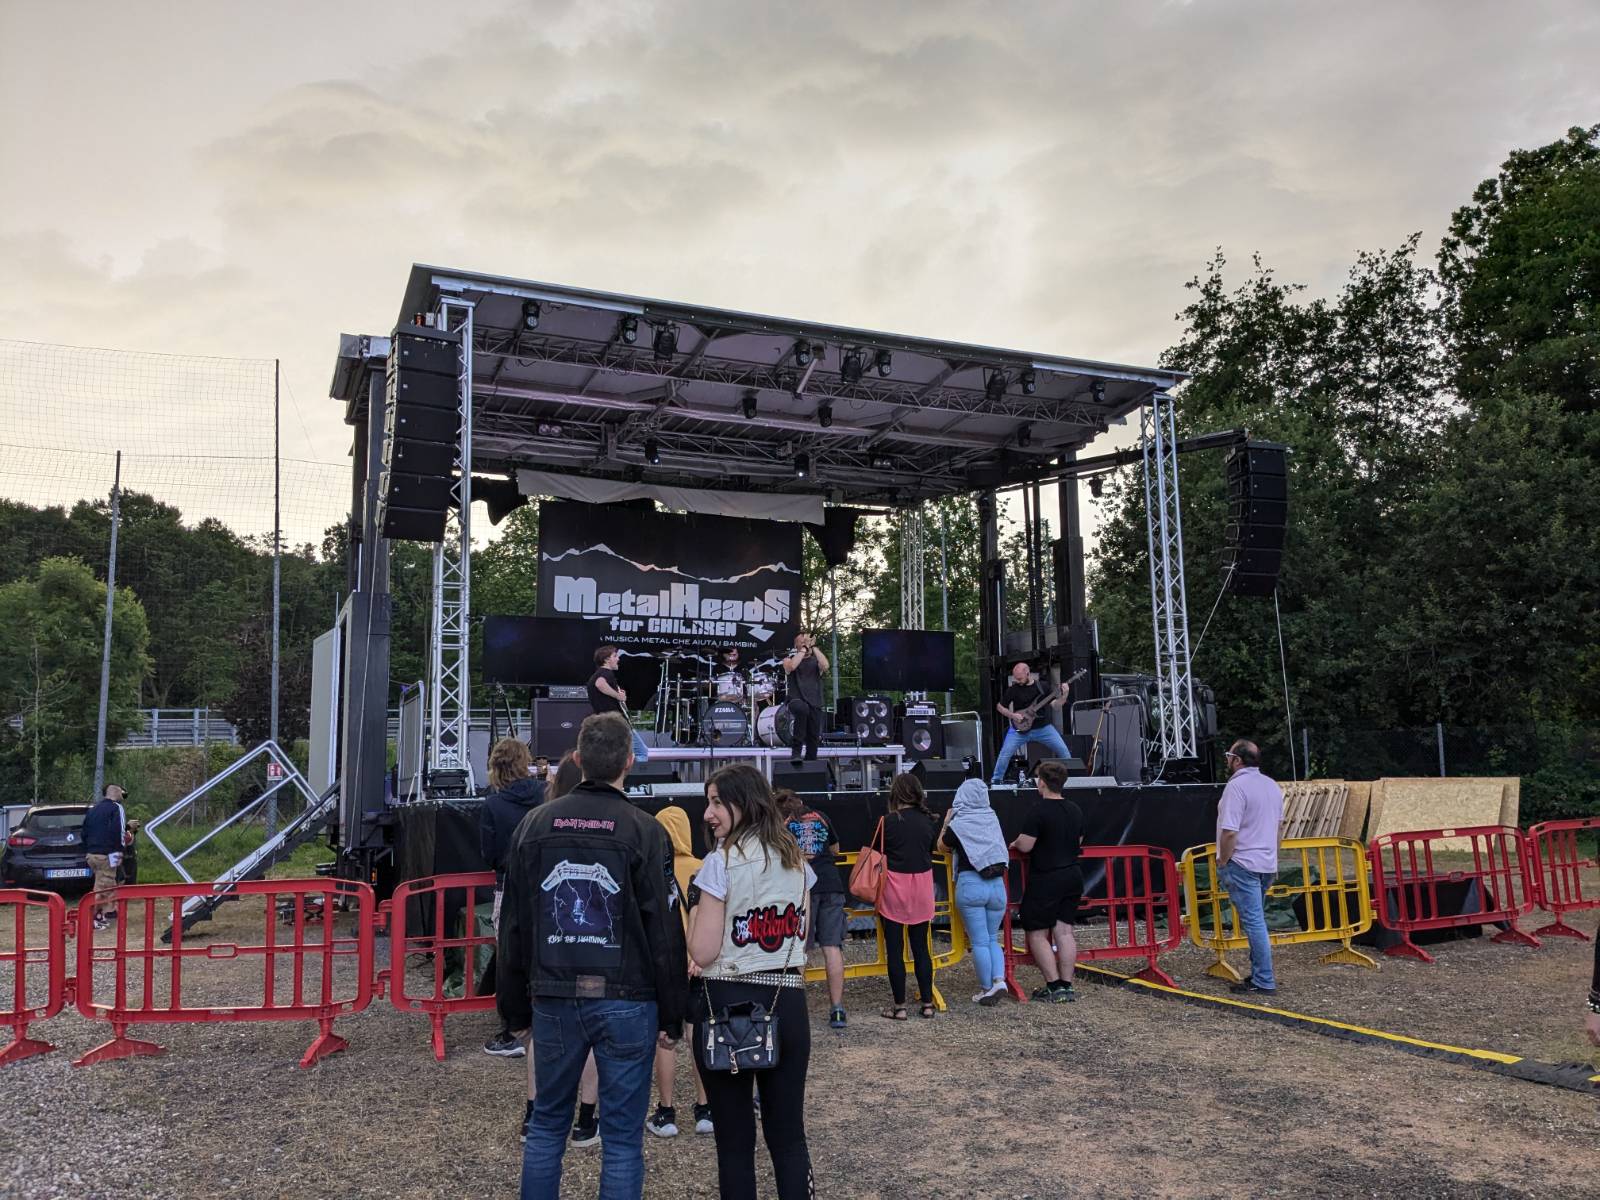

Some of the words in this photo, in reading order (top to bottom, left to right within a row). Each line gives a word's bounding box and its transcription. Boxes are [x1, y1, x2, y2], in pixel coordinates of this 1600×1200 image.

[610, 616, 644, 632] for
[647, 618, 737, 636] CHILDREN
[604, 635, 640, 644] MUSICA
[641, 637, 670, 645] METAL
[672, 638, 691, 646] CHE
